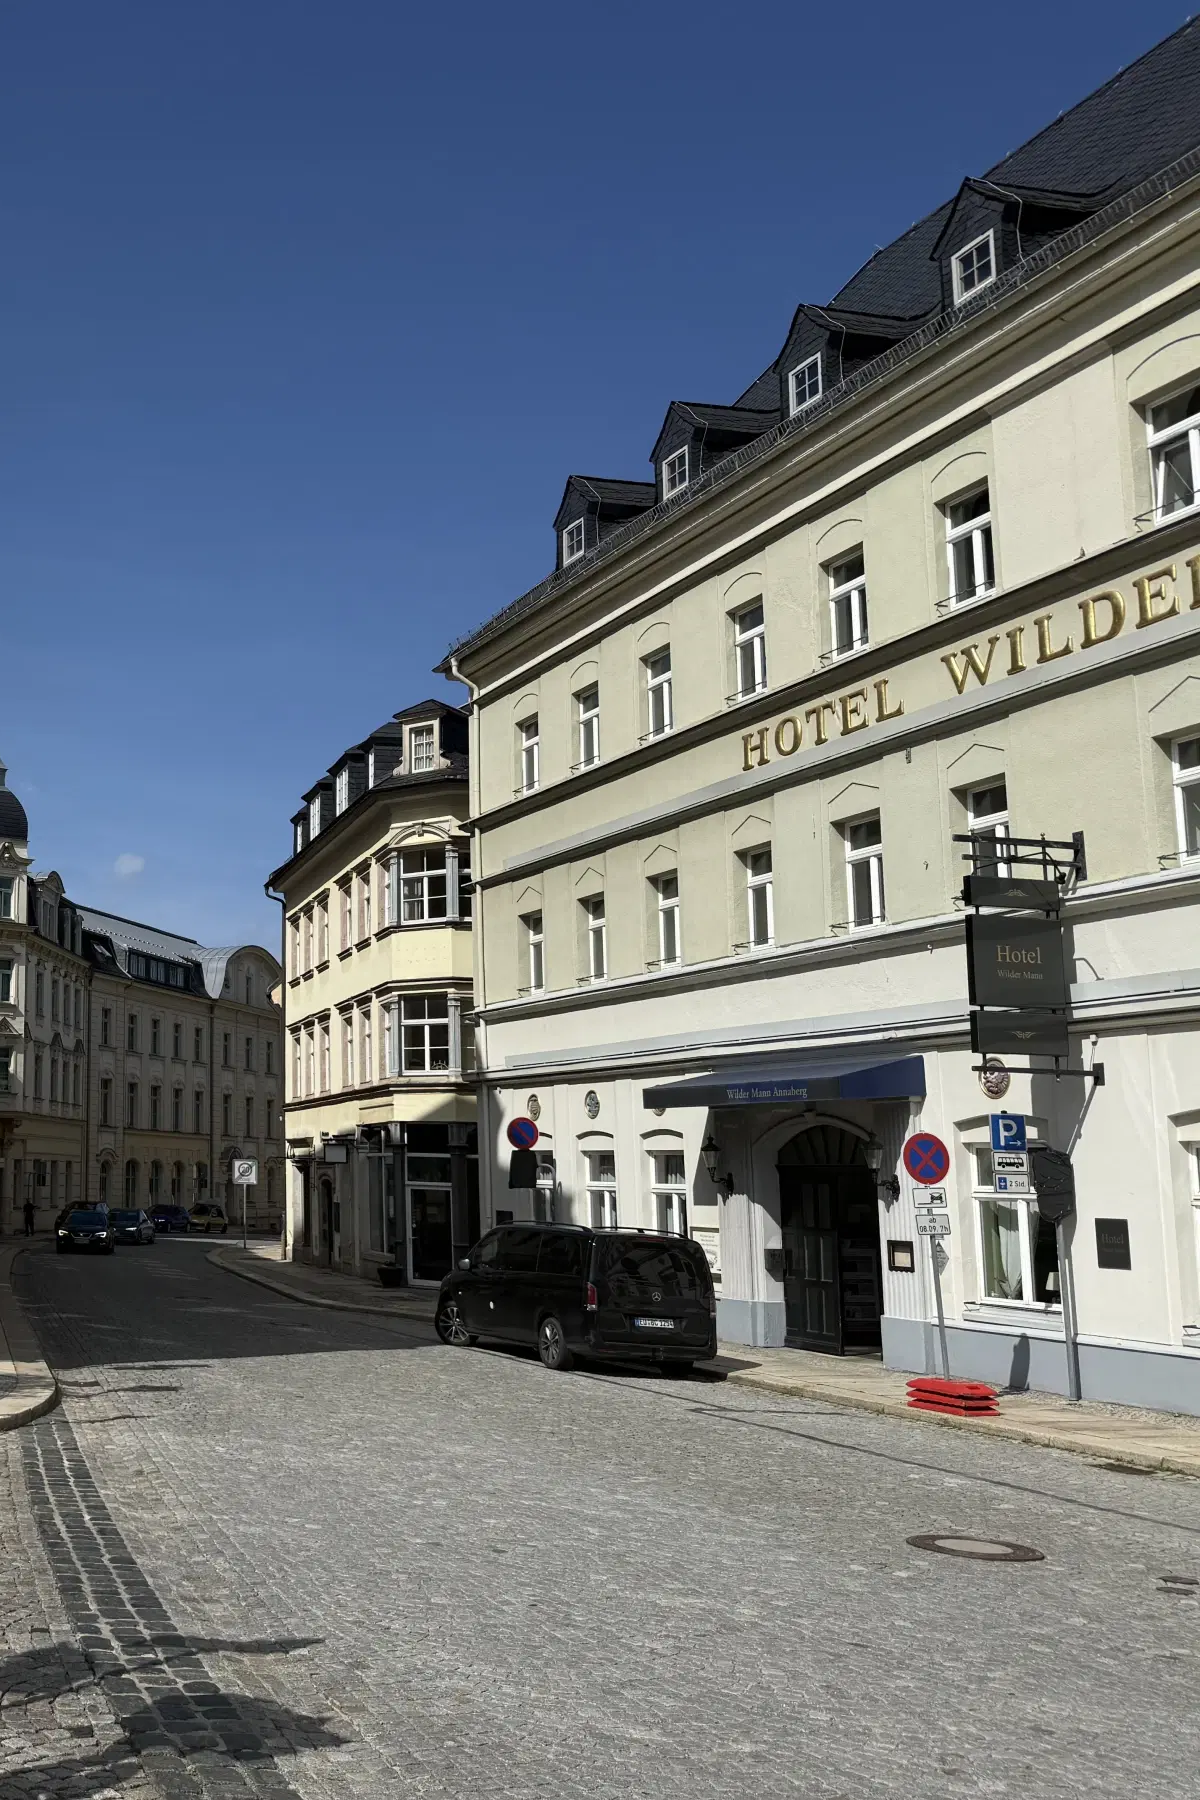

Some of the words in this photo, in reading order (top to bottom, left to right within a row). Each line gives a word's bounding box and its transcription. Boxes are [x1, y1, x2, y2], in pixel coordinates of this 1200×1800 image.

[741, 677, 905, 772] HOTEL
[996, 945, 1043, 964] Hotel
[997, 968, 1021, 979] Wilder
[1023, 971, 1044, 980] Mann
[726, 1088, 750, 1099] Wilder
[751, 1087, 771, 1098] Mann
[773, 1084, 808, 1099] Annaberg
[999, 1118, 1017, 1146] P
